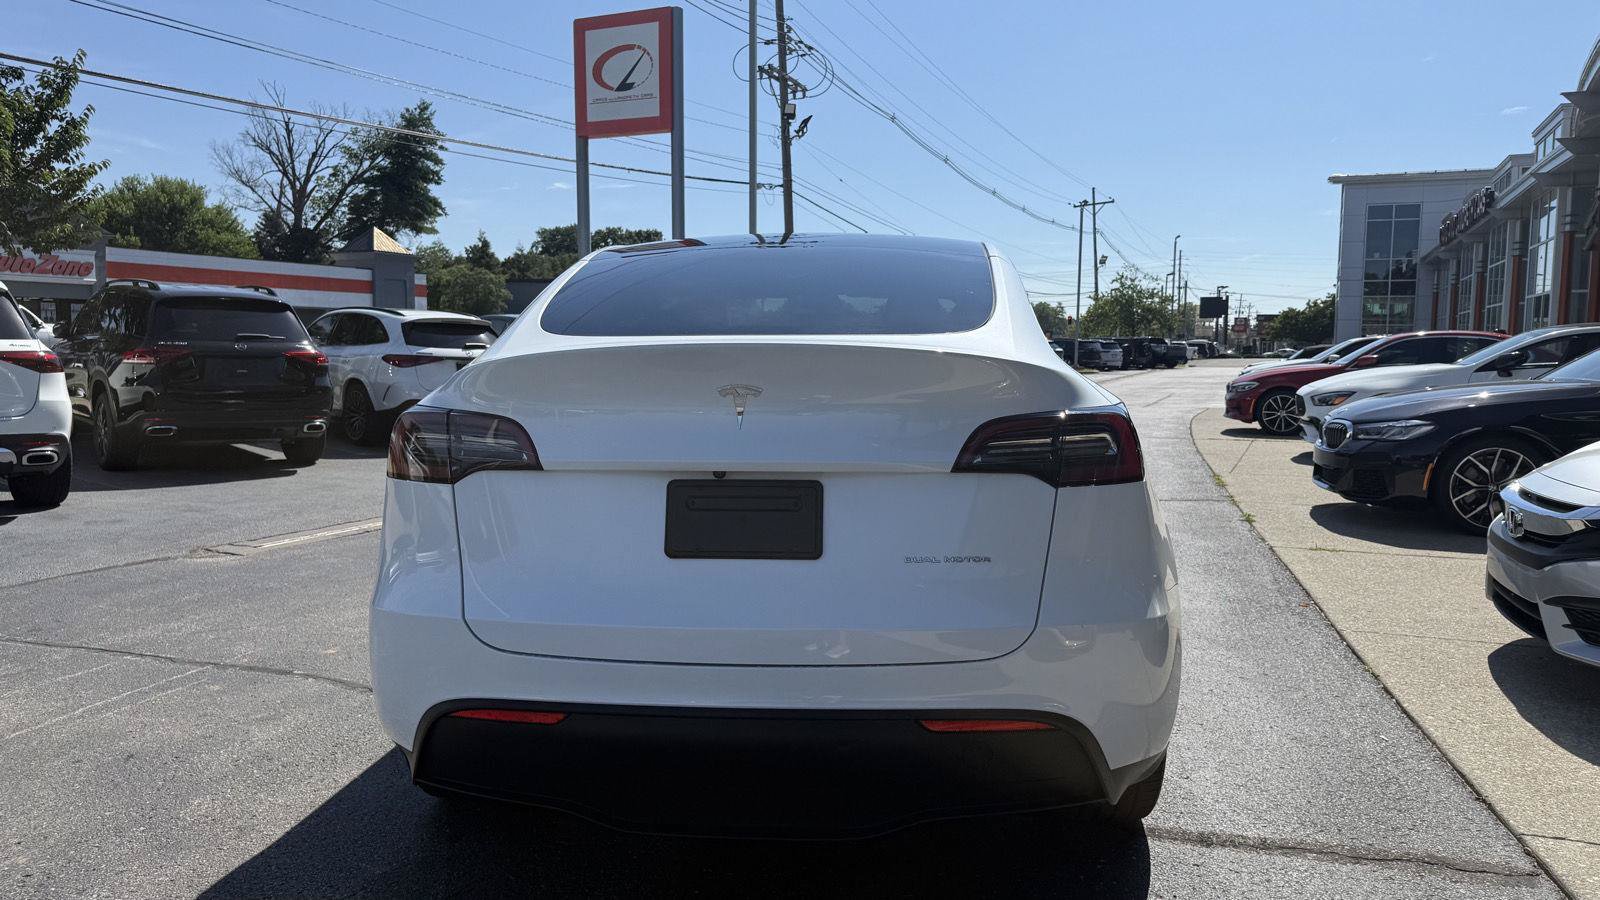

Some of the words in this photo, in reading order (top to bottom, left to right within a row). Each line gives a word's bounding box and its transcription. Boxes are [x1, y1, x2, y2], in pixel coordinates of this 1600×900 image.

[0, 254, 94, 276] utoZone
[904, 556, 941, 564] DUAL
[943, 555, 992, 564] MOTOR
